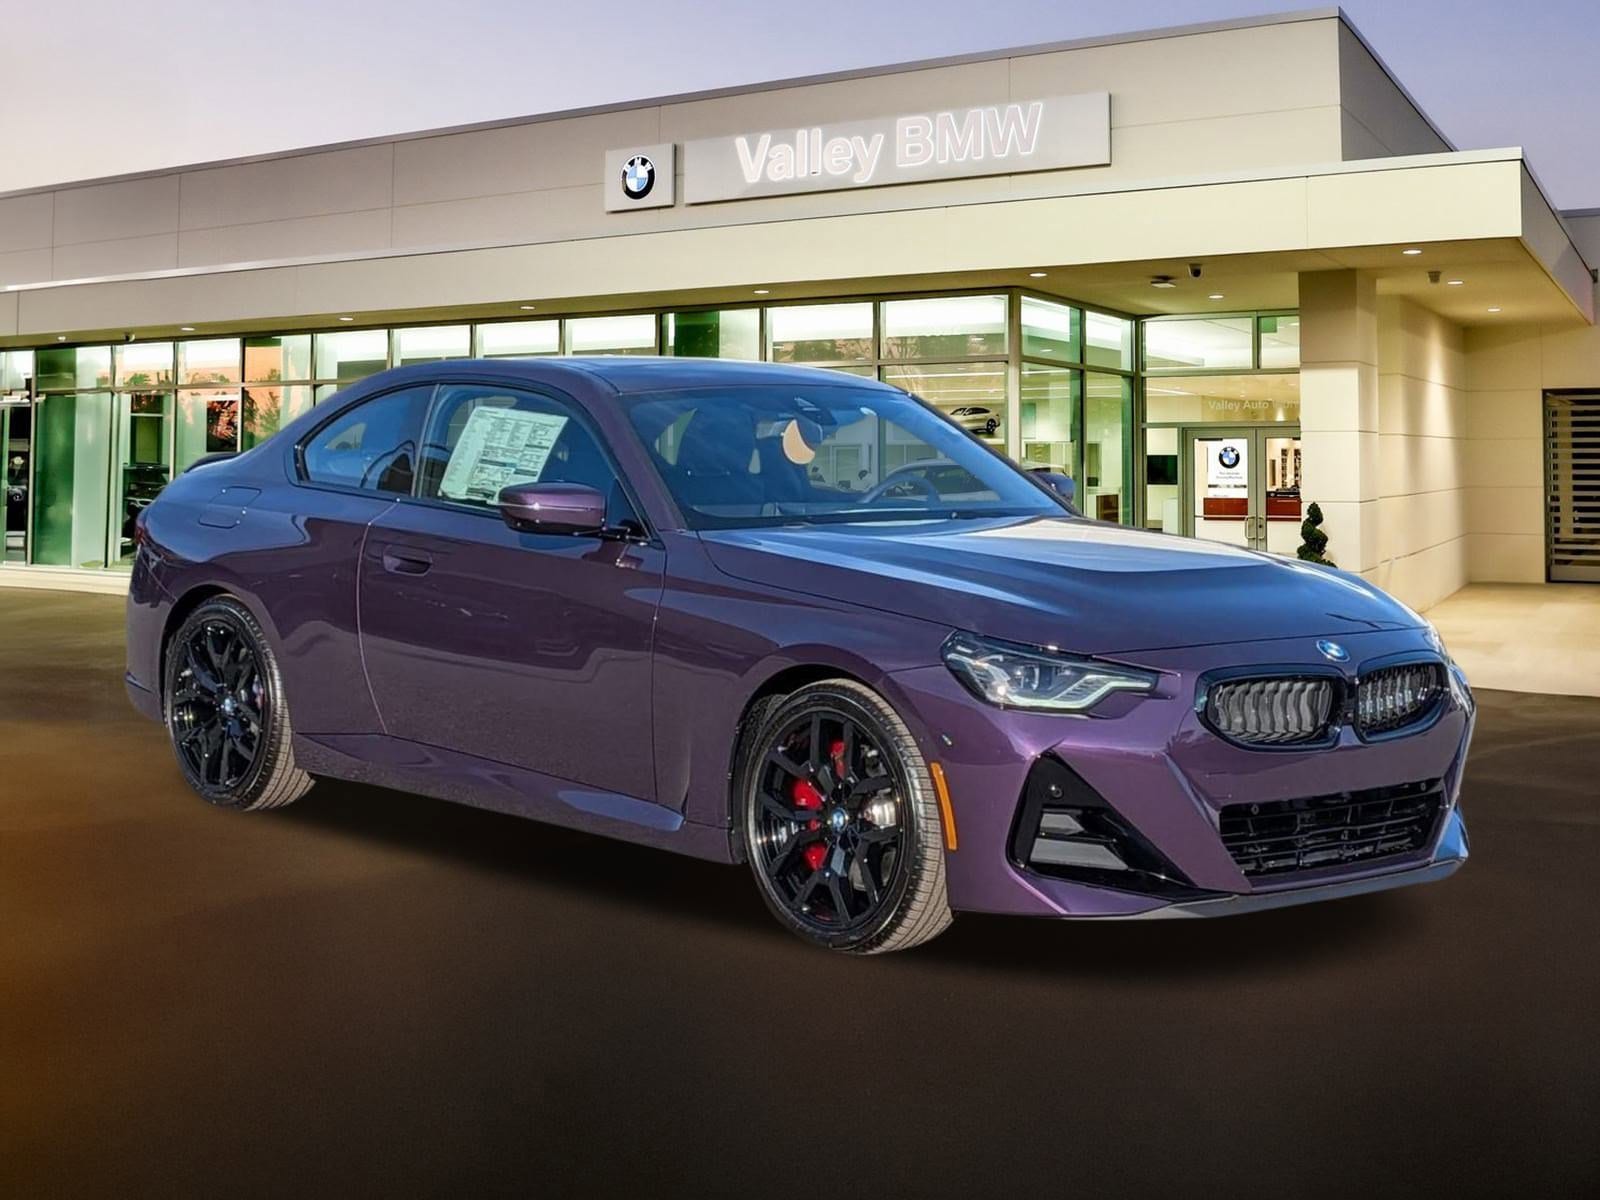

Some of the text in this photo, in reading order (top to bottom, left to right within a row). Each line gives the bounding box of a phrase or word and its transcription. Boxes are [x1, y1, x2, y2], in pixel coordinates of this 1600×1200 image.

[735, 102, 1044, 184] Valley BMW
[1208, 400, 1240, 412] Valley
[1243, 400, 1269, 409] Auto
